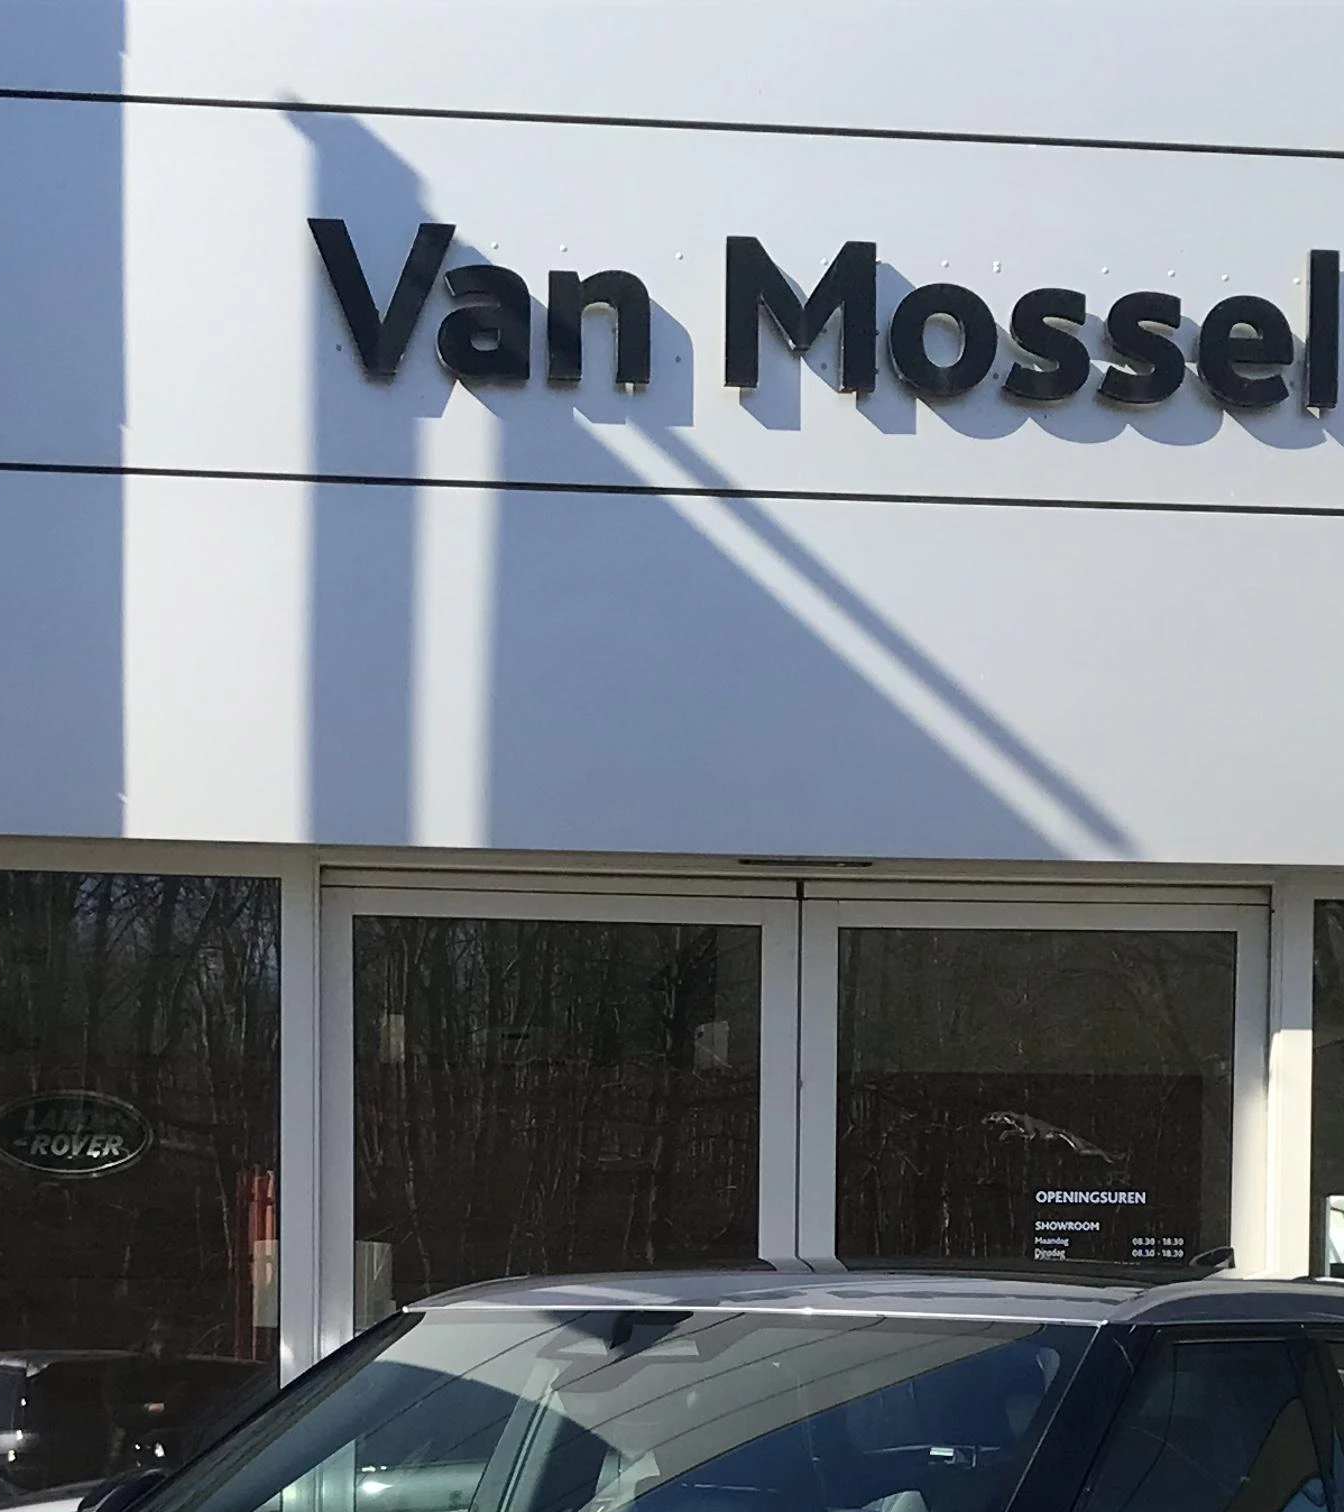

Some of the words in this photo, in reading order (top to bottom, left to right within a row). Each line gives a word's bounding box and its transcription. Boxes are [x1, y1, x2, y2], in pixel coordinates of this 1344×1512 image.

[307, 217, 650, 386] Van
[724, 235, 1340, 409] Mossel
[30, 1134, 124, 1157] ROVER
[1035, 1191, 1146, 1204] OPENINGSUREN
[1034, 1221, 1100, 1231] SHOWROOM
[1034, 1237, 1069, 1246] Maandag
